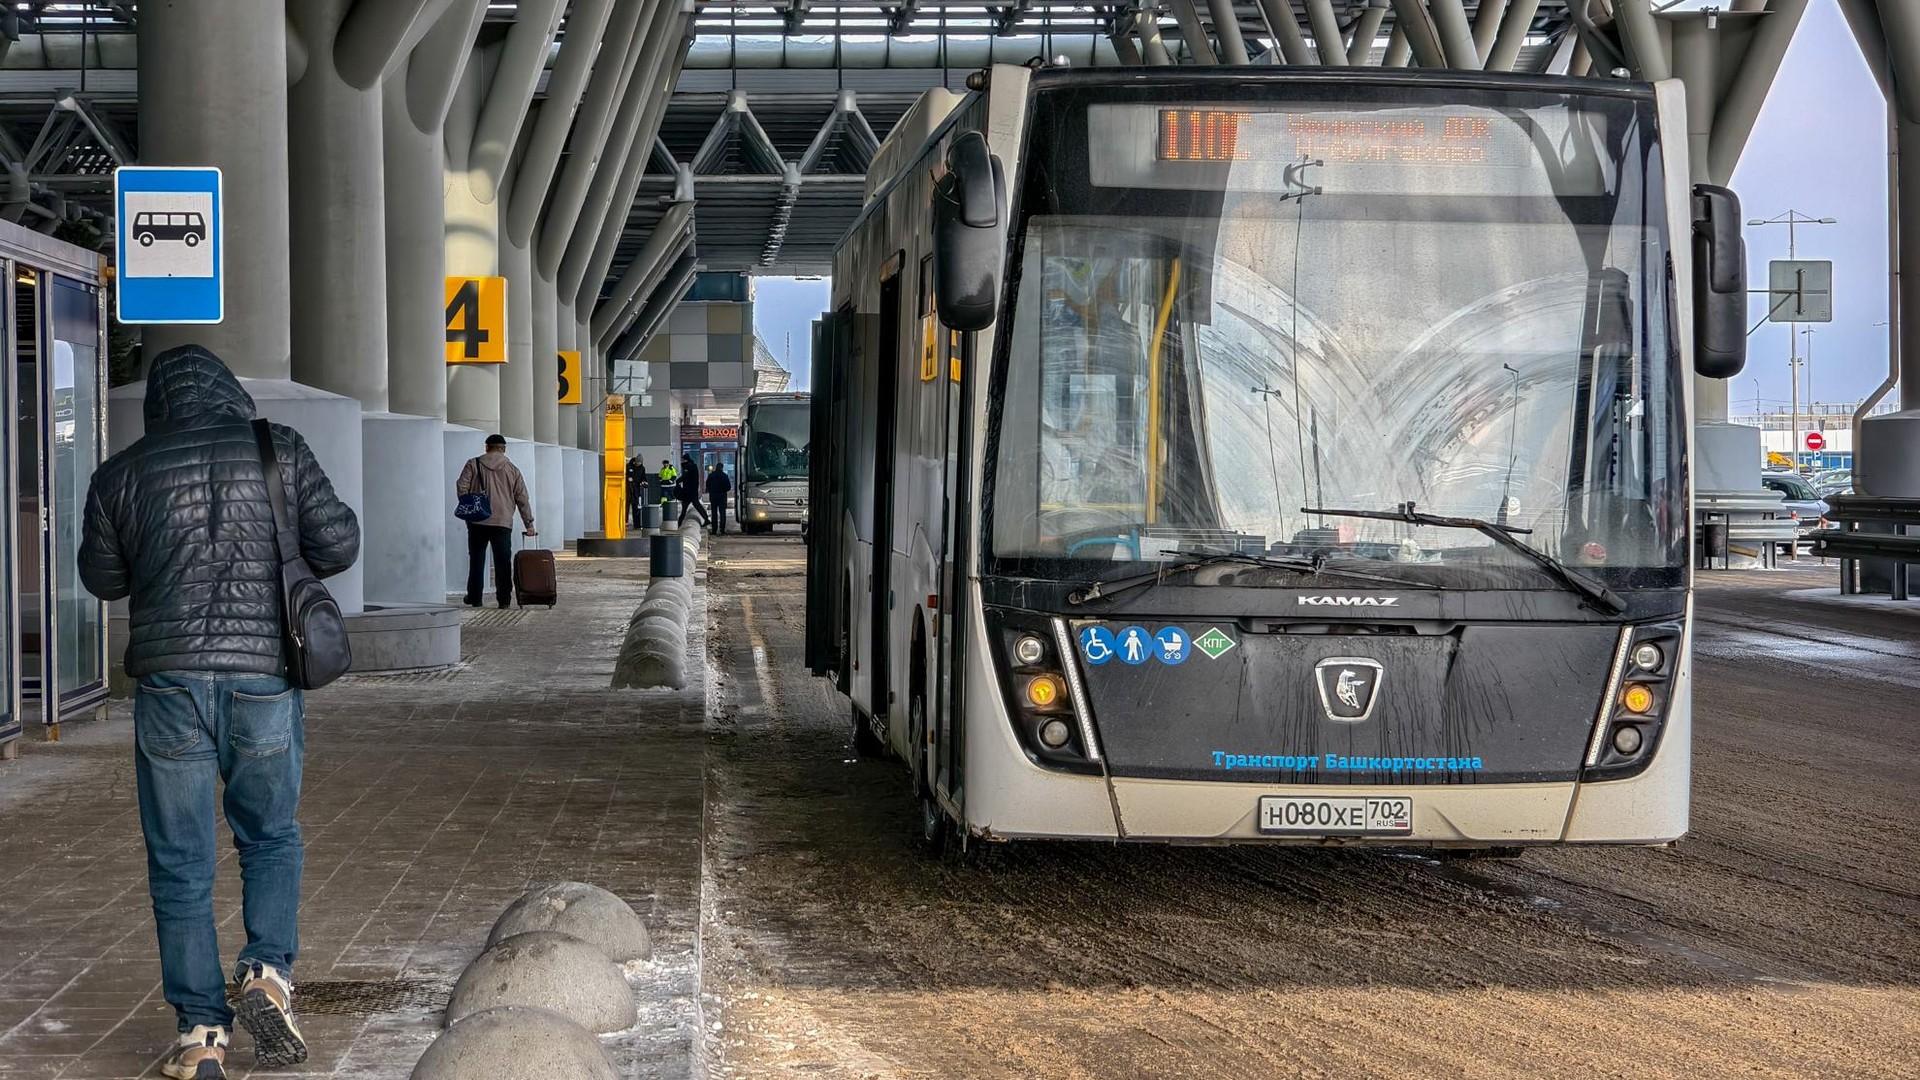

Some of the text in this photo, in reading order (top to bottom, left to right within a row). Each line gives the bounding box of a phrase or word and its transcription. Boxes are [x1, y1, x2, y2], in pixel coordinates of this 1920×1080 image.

[1442, 117, 1492, 140] ДОК
[445, 279, 489, 358] 4
[702, 428, 738, 439] ВЫХОД
[1297, 595, 1400, 607] KAMAZ
[1203, 638, 1227, 648] КПГ
[1212, 751, 1482, 773] Транспорт Башкортостана
[1369, 801, 1404, 819] 702
